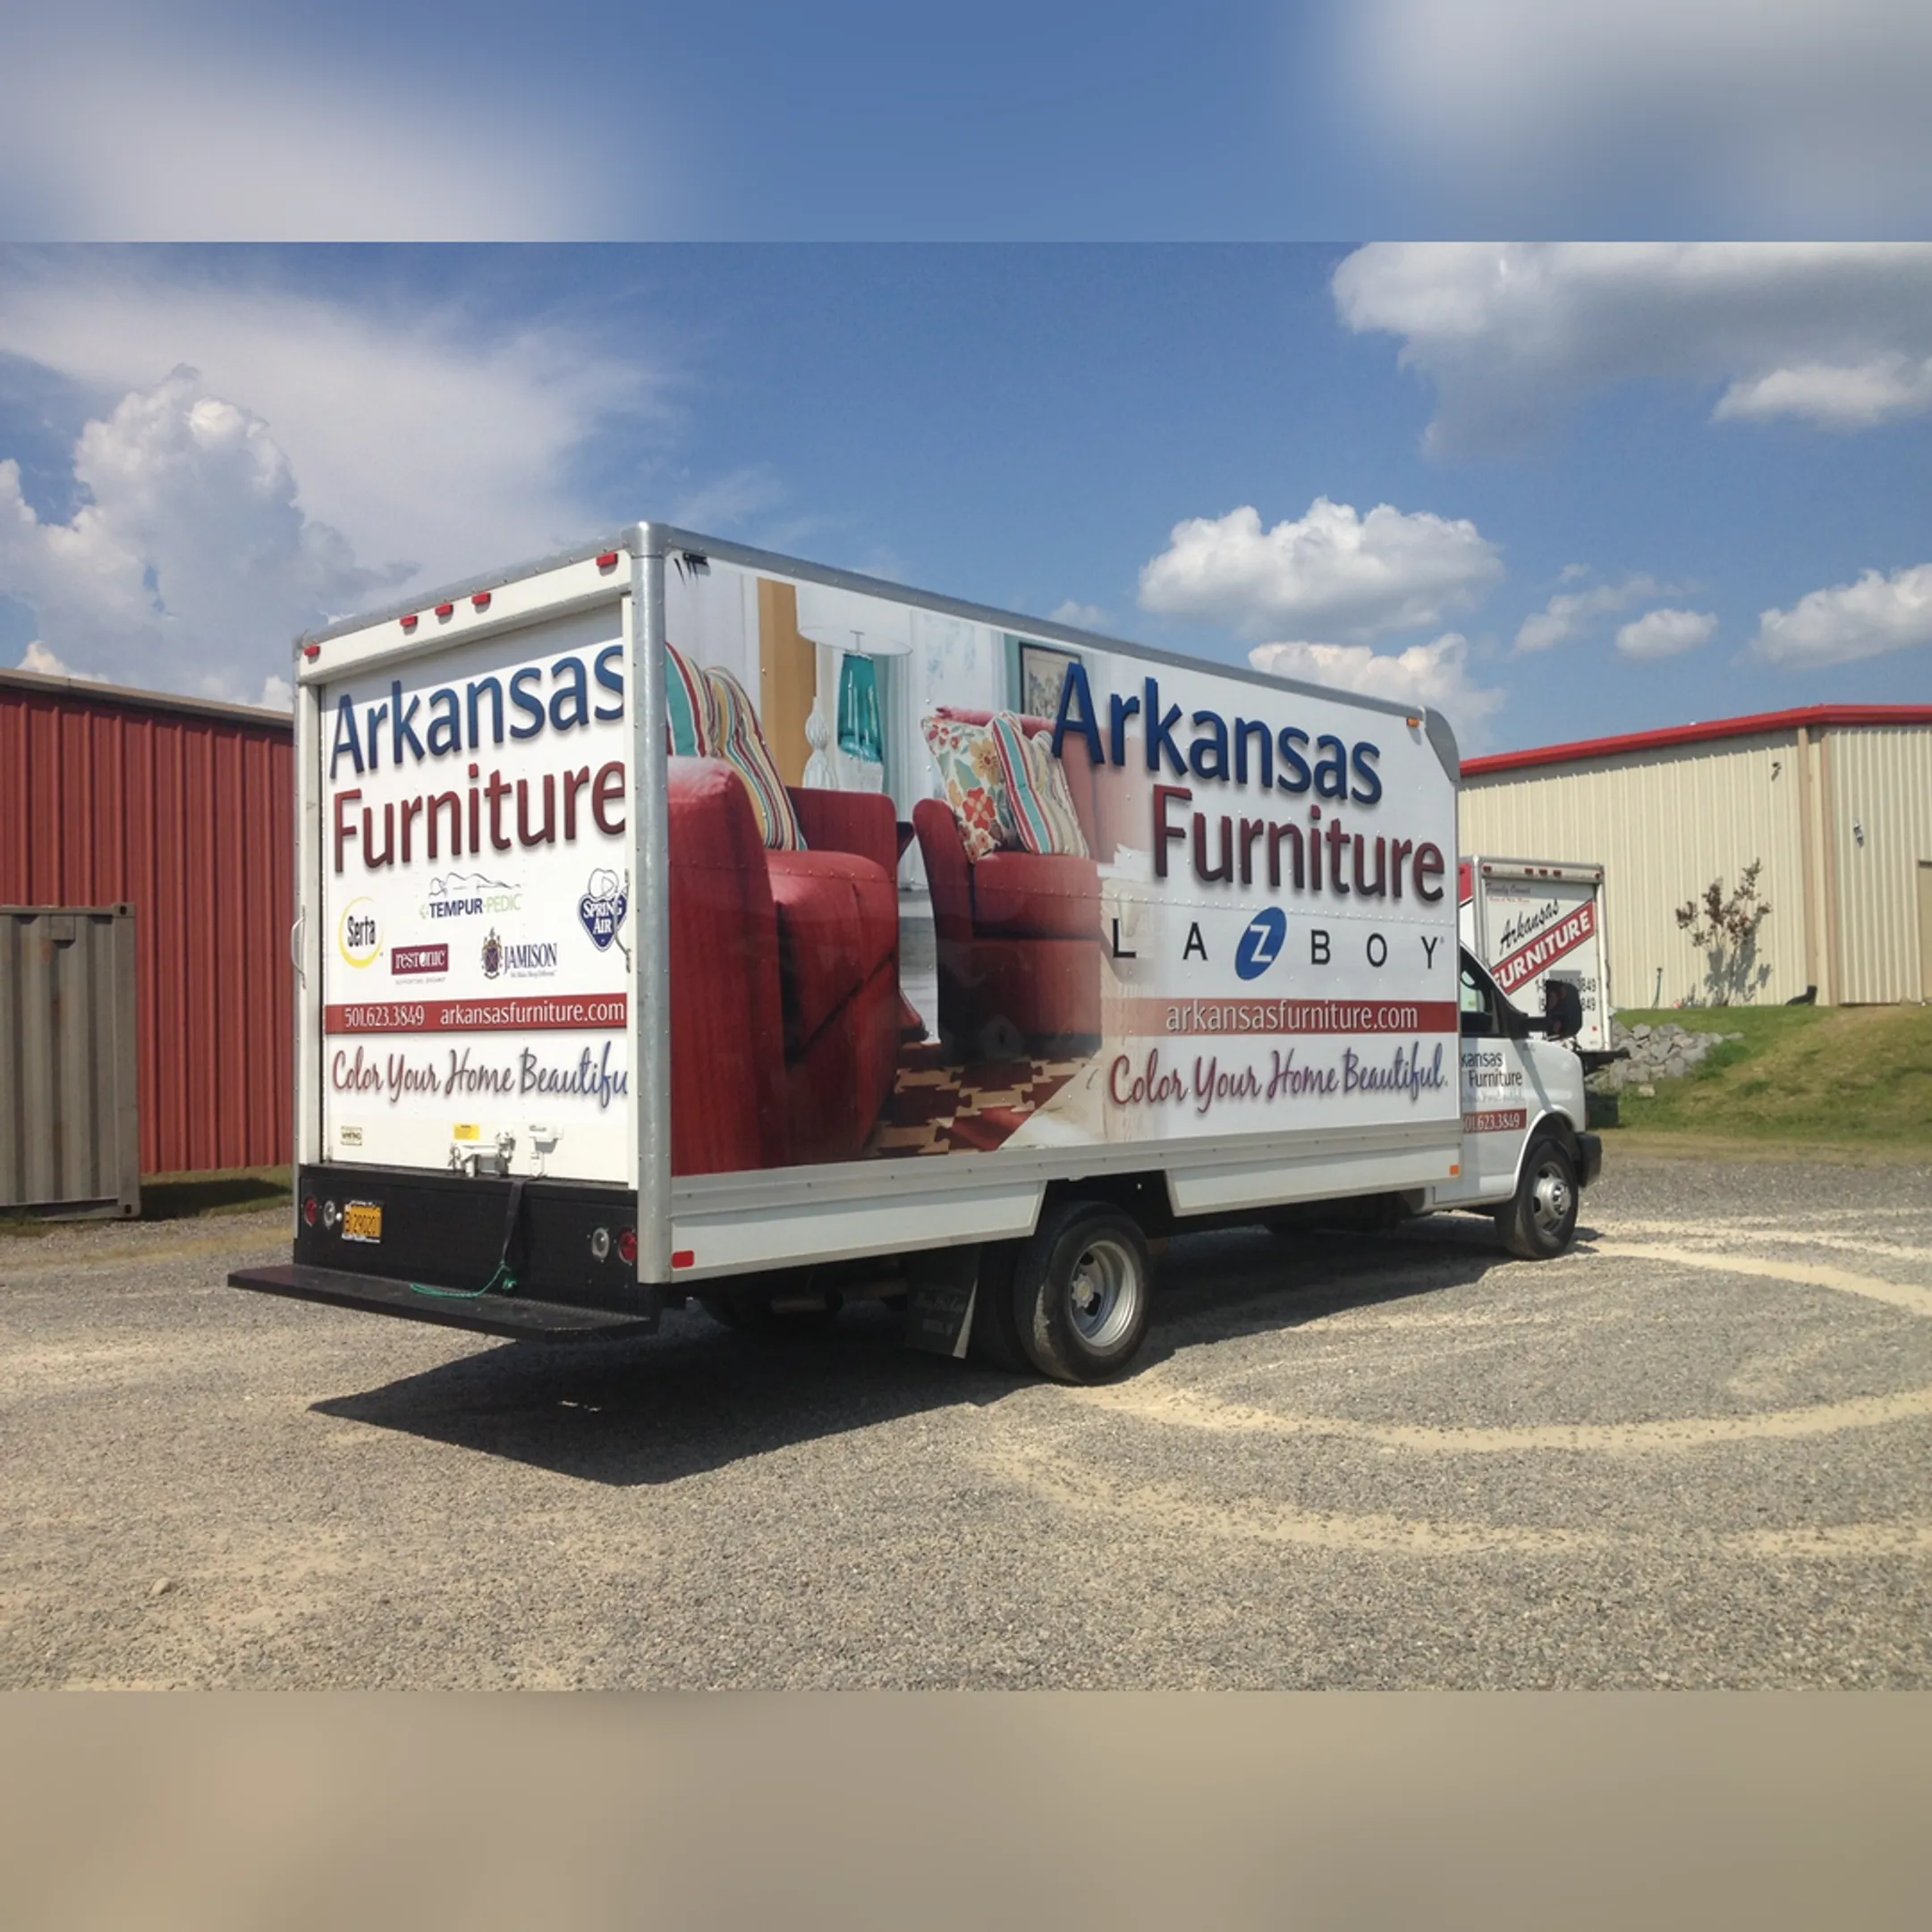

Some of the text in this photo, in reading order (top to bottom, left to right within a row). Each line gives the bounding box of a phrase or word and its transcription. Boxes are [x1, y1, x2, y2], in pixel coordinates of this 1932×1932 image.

[329, 644, 623, 780] Arkansas
[1052, 662, 1382, 804] Arkansas
[334, 760, 626, 873] Furniture
[1153, 784, 1445, 902] Furniture
[347, 915, 376, 947] Serta
[592, 918, 613, 935] AIR
[1499, 898, 1559, 956] Arkansas
[504, 942, 557, 975] JAMISON
[344, 1000, 624, 1028] 501.623.3849 arkansasfurniture.com
[1166, 999, 1418, 1031] arkansasfurniture.com
[333, 1046, 384, 1094] Color
[387, 1053, 441, 1104] Your
[445, 1047, 515, 1095] Home
[1110, 1047, 1190, 1106] Color
[1194, 1055, 1262, 1114] Your
[1266, 1047, 1340, 1100] Home
[1469, 1069, 1523, 1087] Furniture
[1463, 1112, 1521, 1131] 01.623.3849
